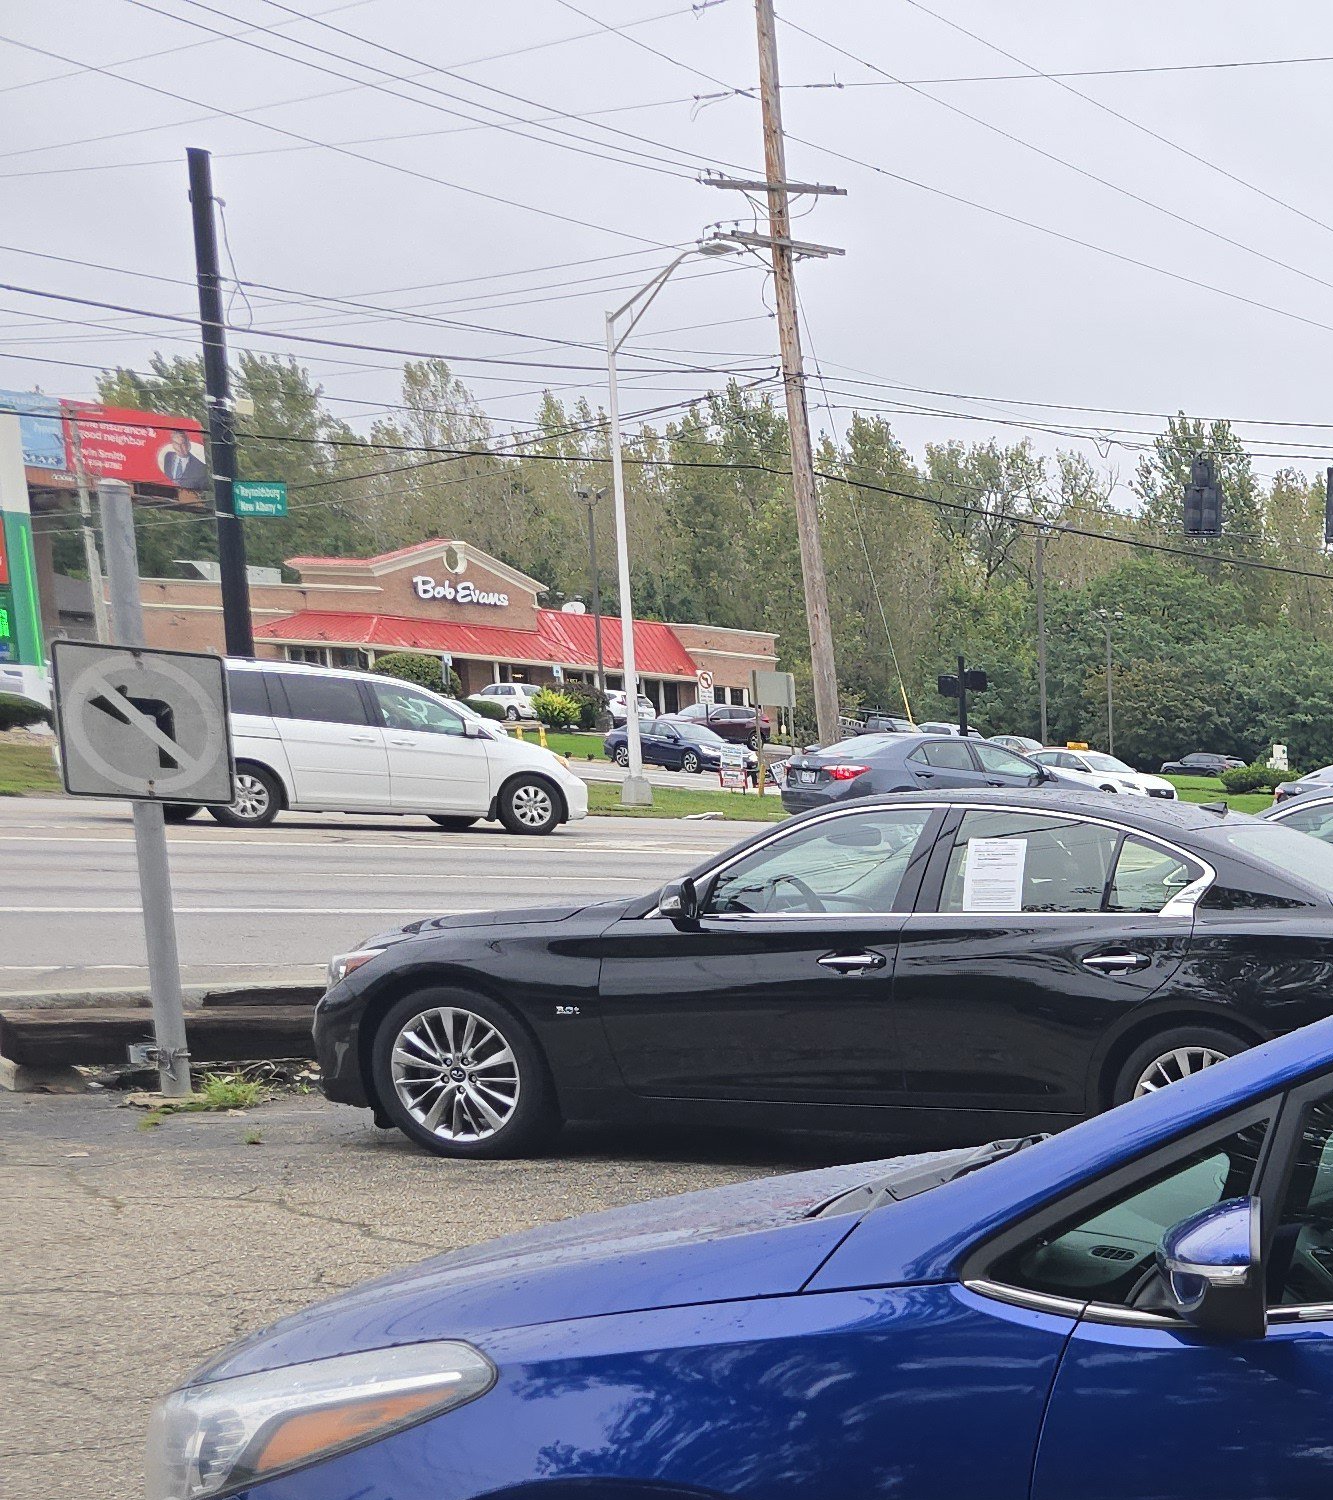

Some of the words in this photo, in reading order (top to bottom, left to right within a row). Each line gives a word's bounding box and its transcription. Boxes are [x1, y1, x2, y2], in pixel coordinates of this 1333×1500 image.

[103, 433, 147, 446] neighbor
[413, 576, 456, 599] Bob
[456, 581, 509, 606] Evans
